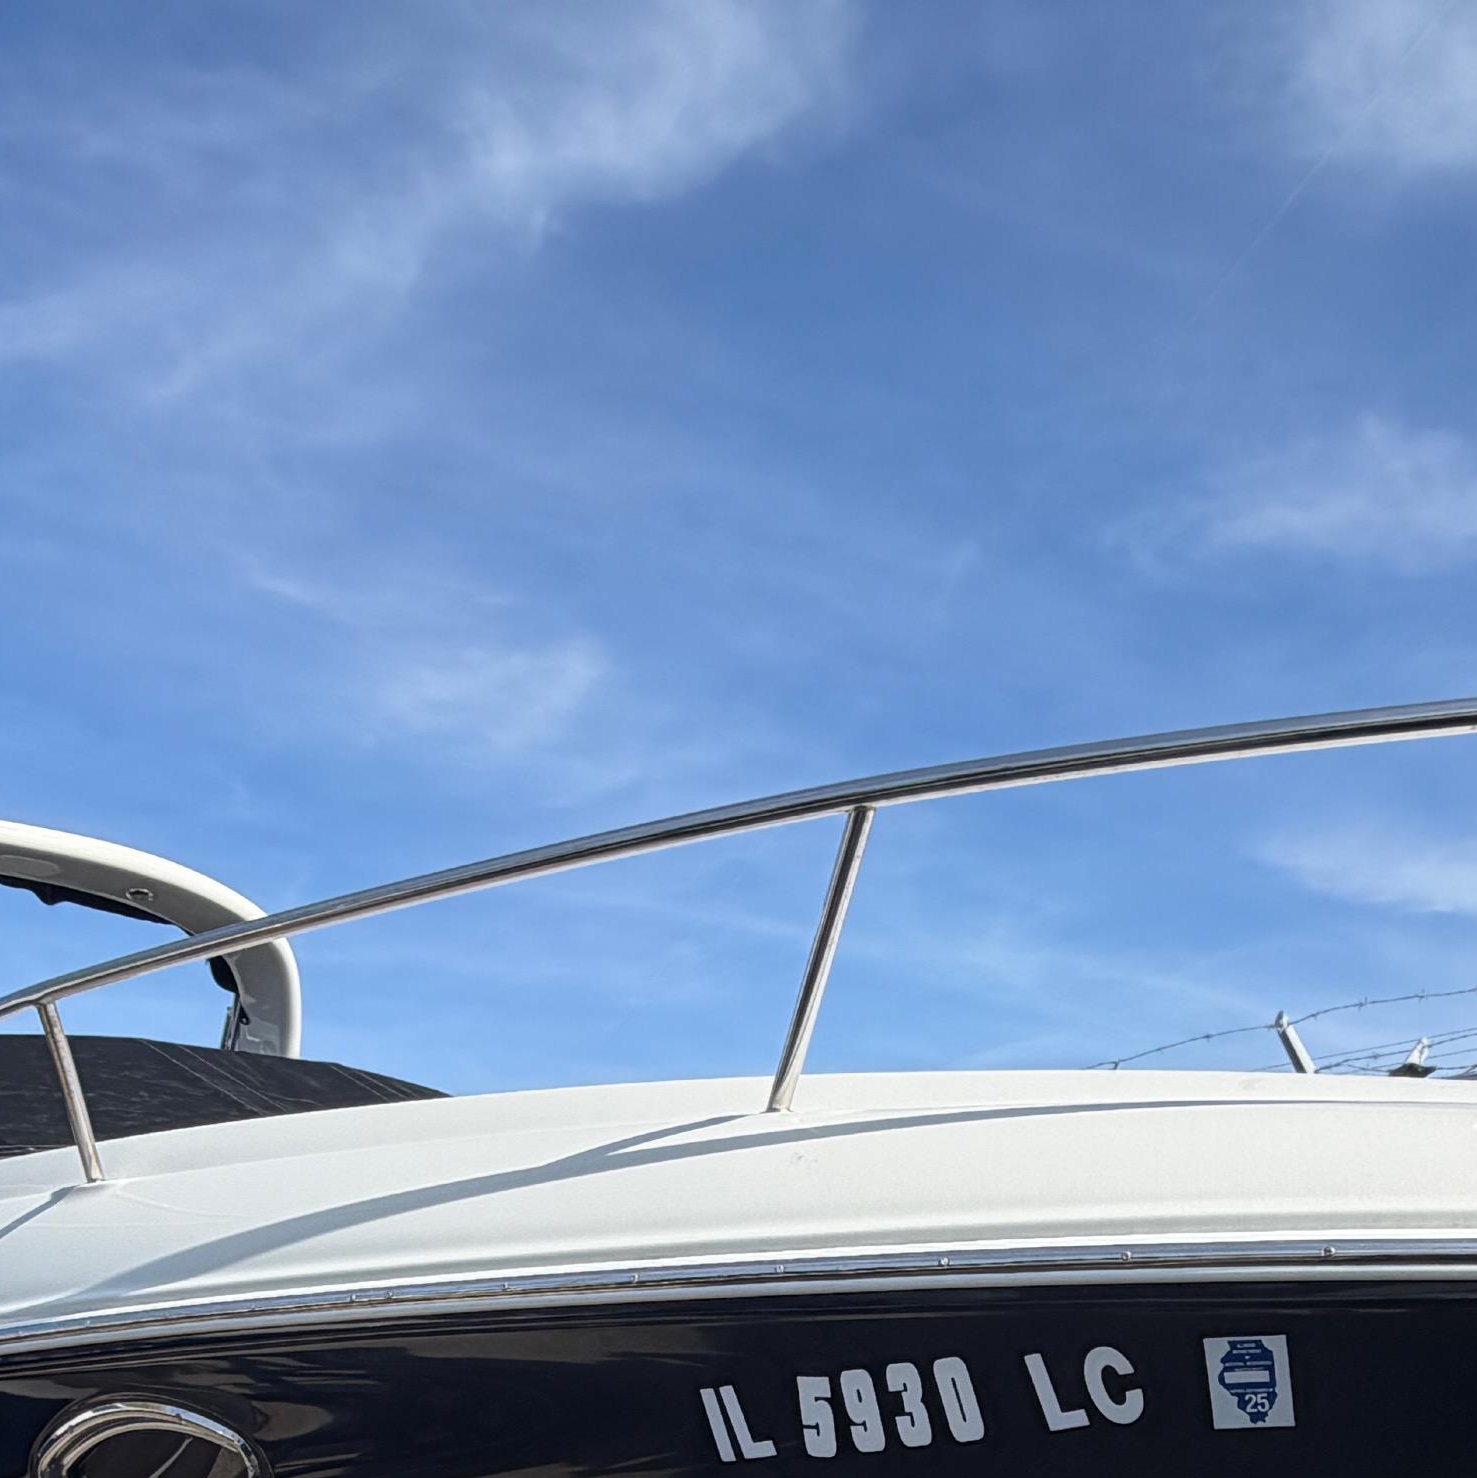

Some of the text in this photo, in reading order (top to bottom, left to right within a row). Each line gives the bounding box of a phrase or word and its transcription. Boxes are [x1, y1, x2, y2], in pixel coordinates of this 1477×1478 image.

[700, 1345, 1145, 1462] IL 5930 LC
[1244, 1393, 1271, 1413] 25
